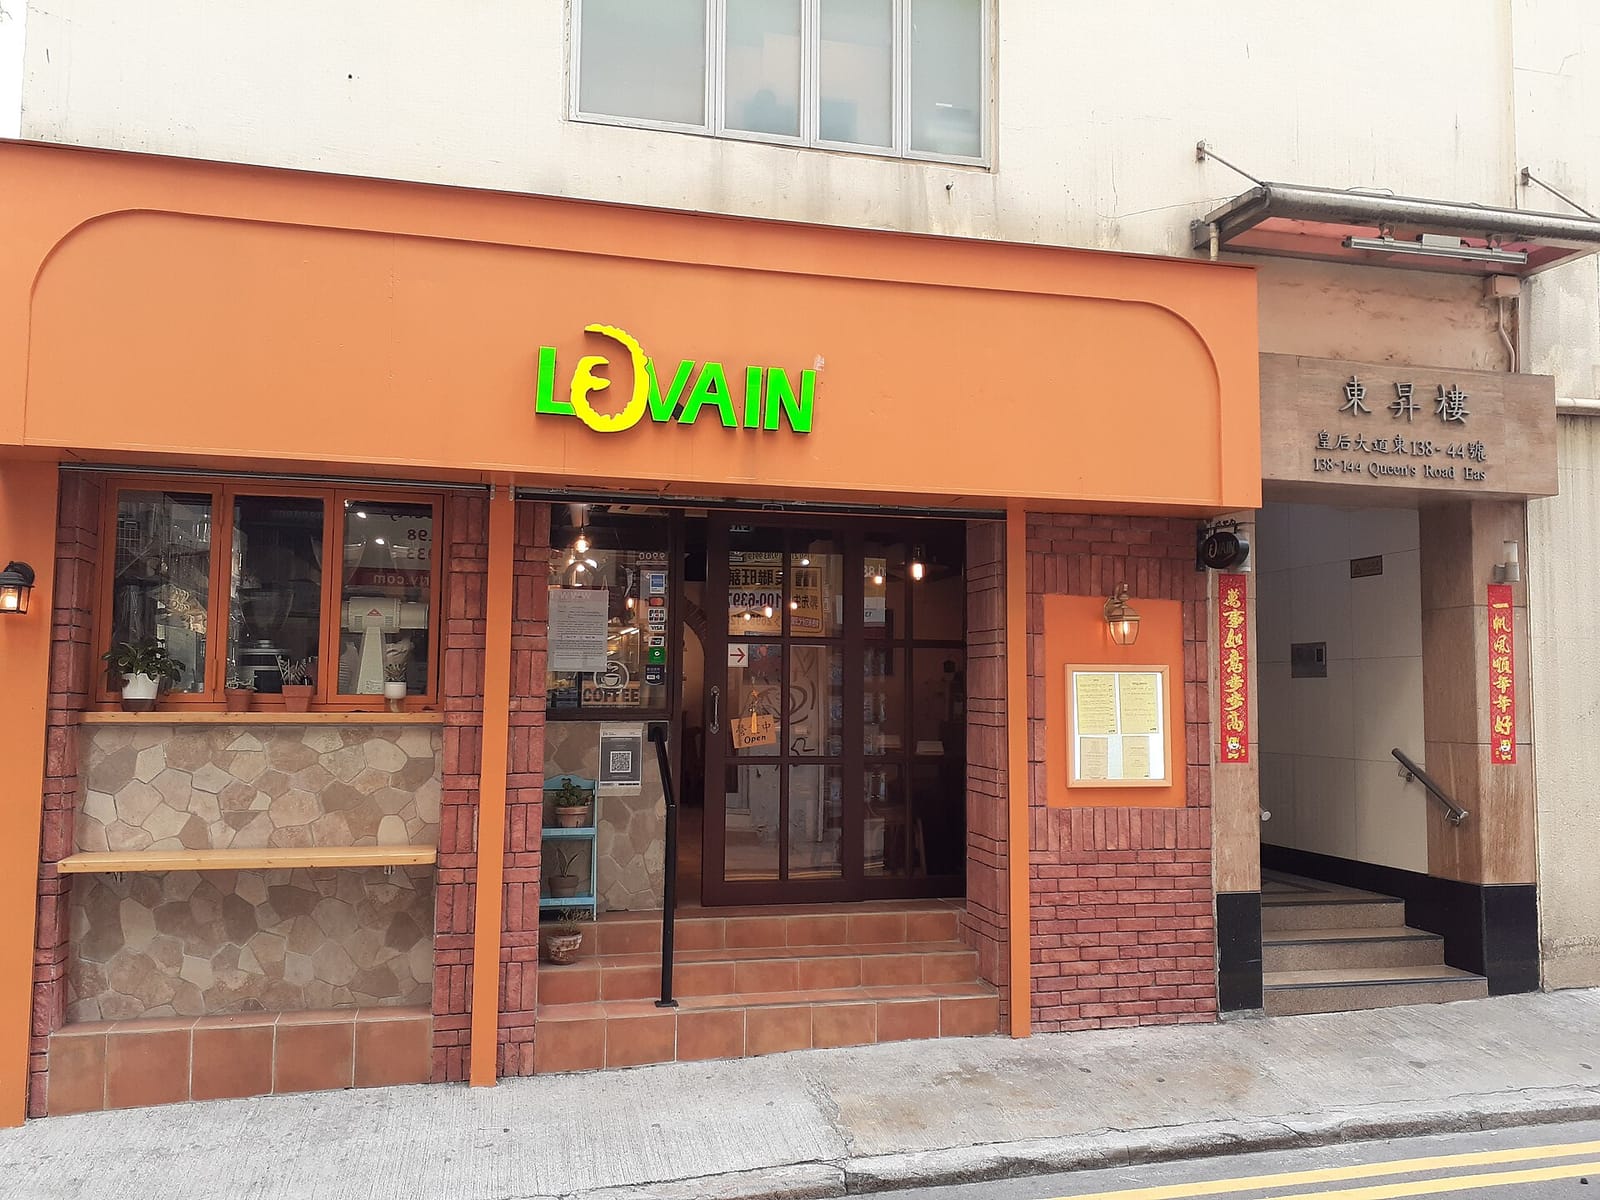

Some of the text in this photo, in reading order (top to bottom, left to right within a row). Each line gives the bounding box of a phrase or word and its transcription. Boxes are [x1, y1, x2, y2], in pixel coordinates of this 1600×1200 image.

[1339, 375, 1471, 423] 東昇樓
[1313, 457, 1487, 481] 138-144 Queen's Road Eas
[1222, 588, 1245, 733] 萬事如意步步高
[1492, 602, 1513, 736] 一帆風順年年好
[744, 735, 767, 744] Open
